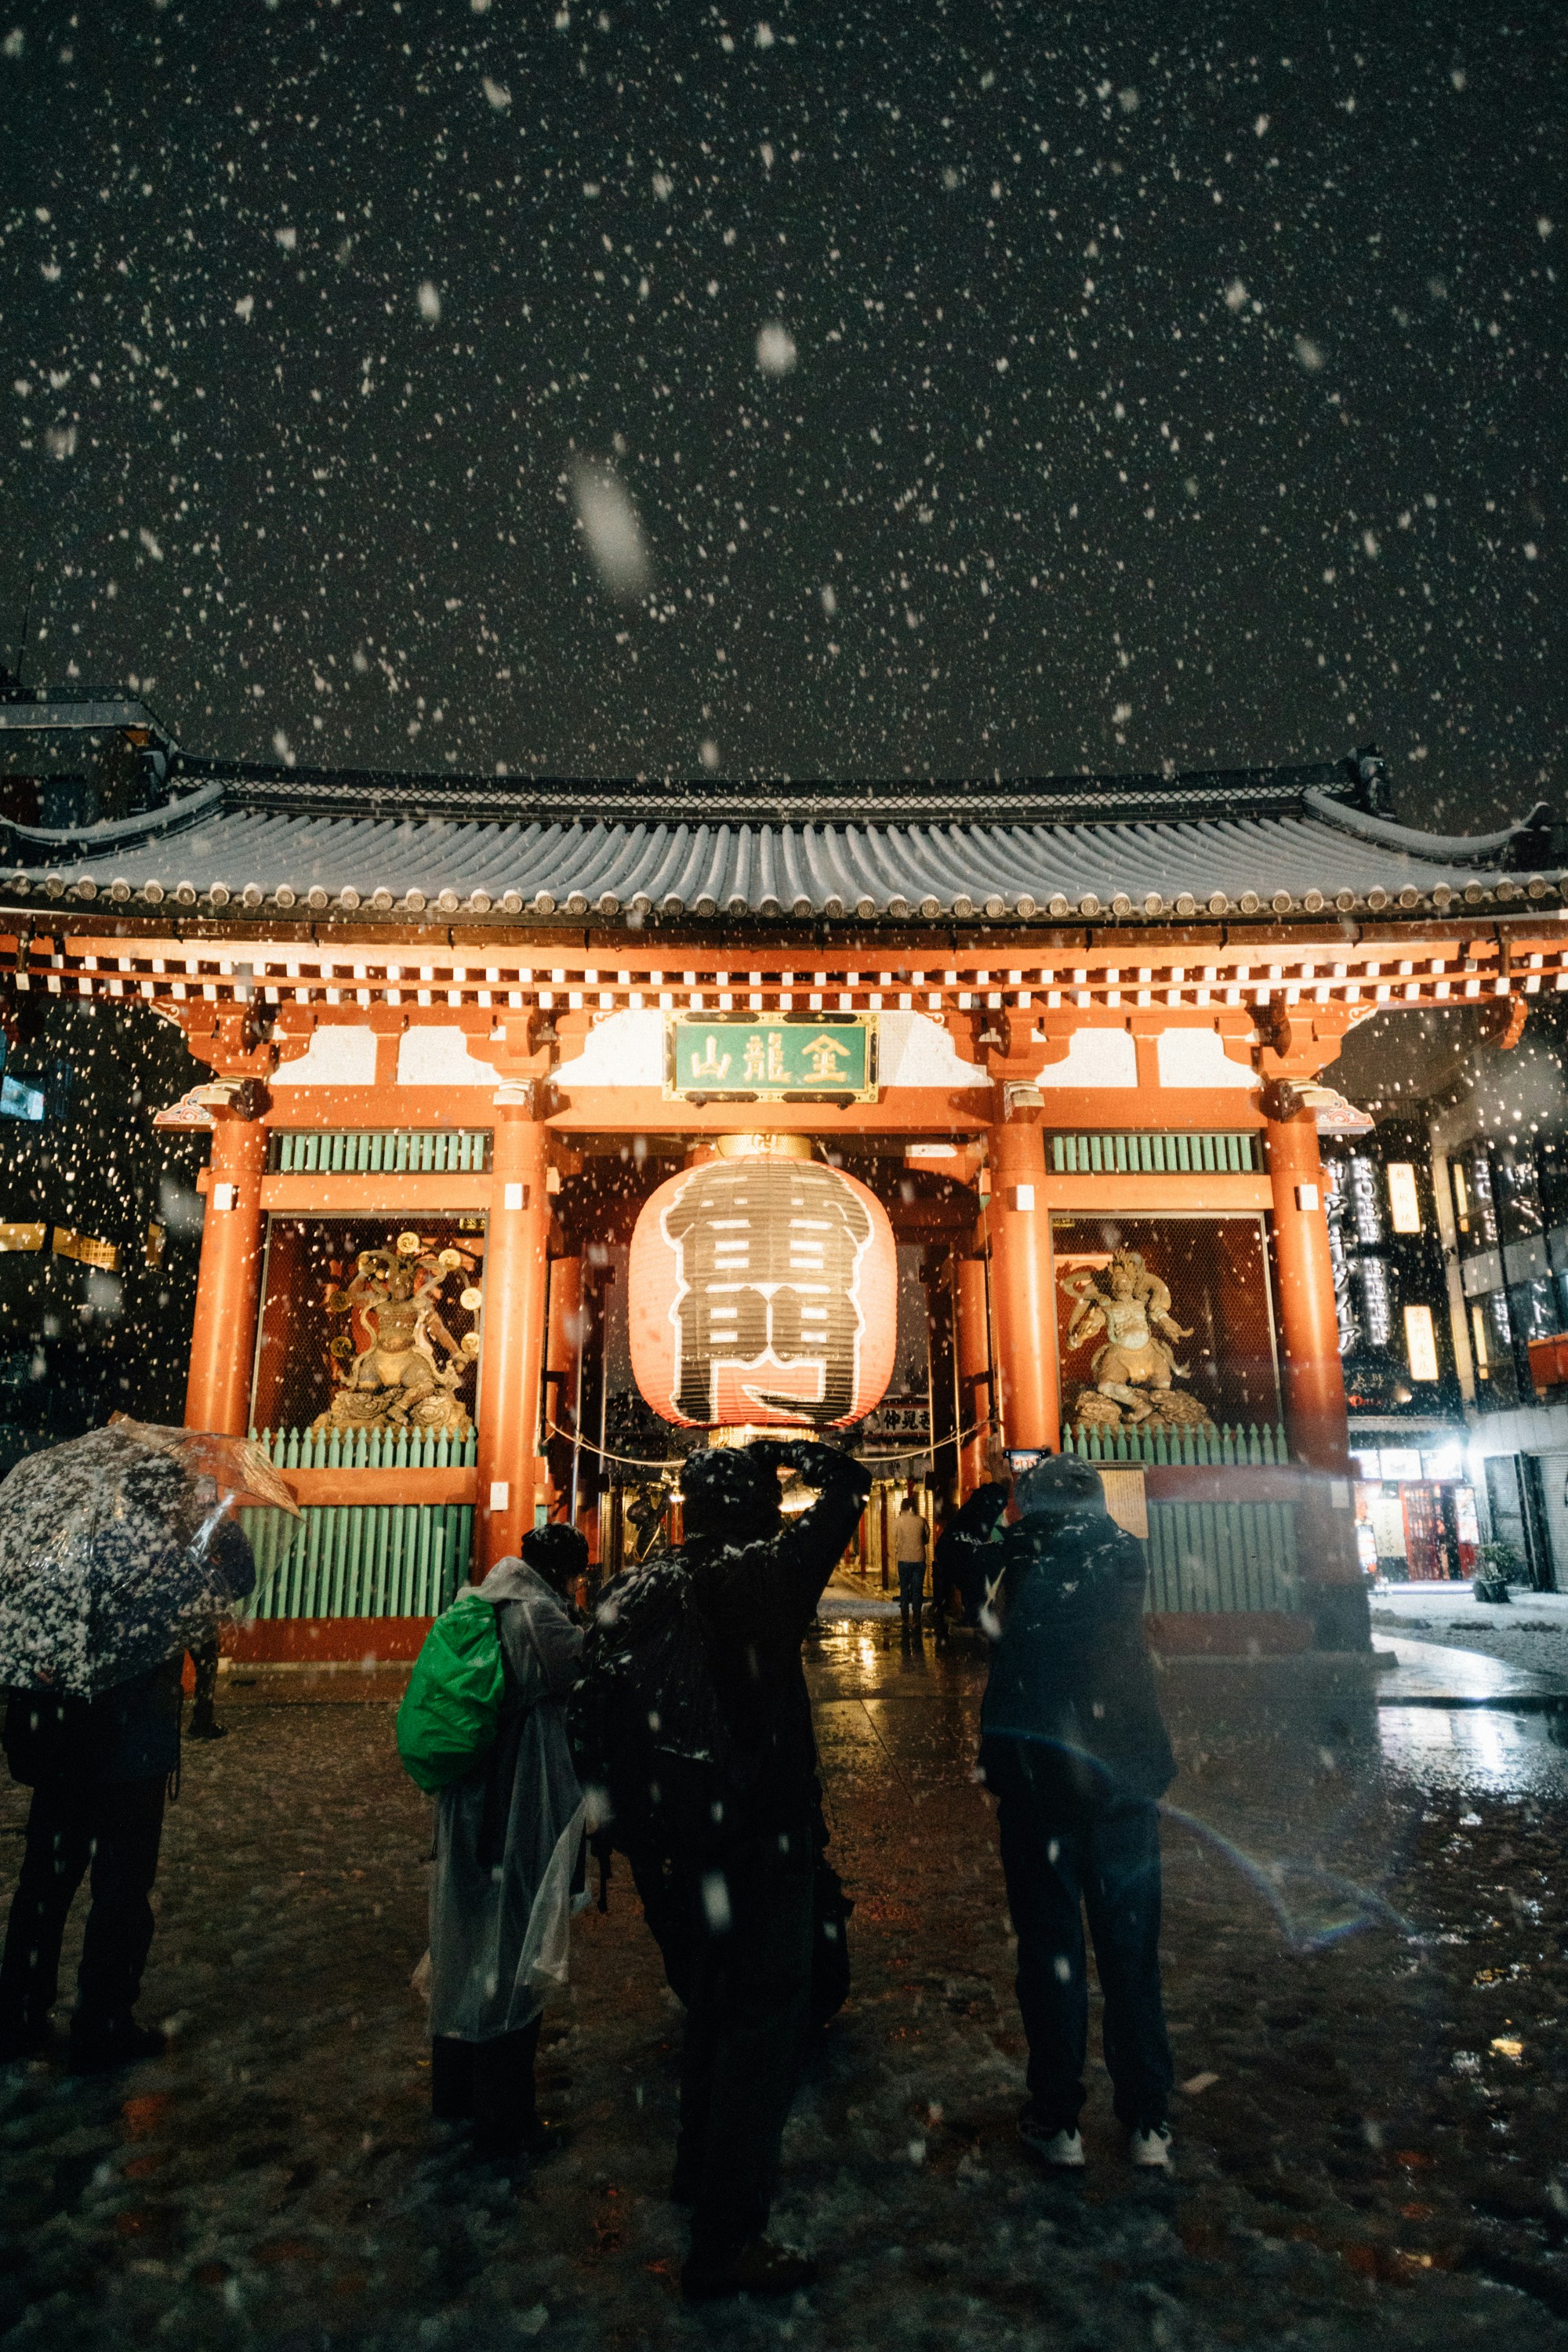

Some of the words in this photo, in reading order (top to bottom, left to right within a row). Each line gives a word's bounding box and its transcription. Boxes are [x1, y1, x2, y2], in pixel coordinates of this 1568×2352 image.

[1353, 1159, 1380, 1242] KOBE
[660, 1161, 874, 1425] 雷門
[1364, 1258, 1388, 1345] BEEF
